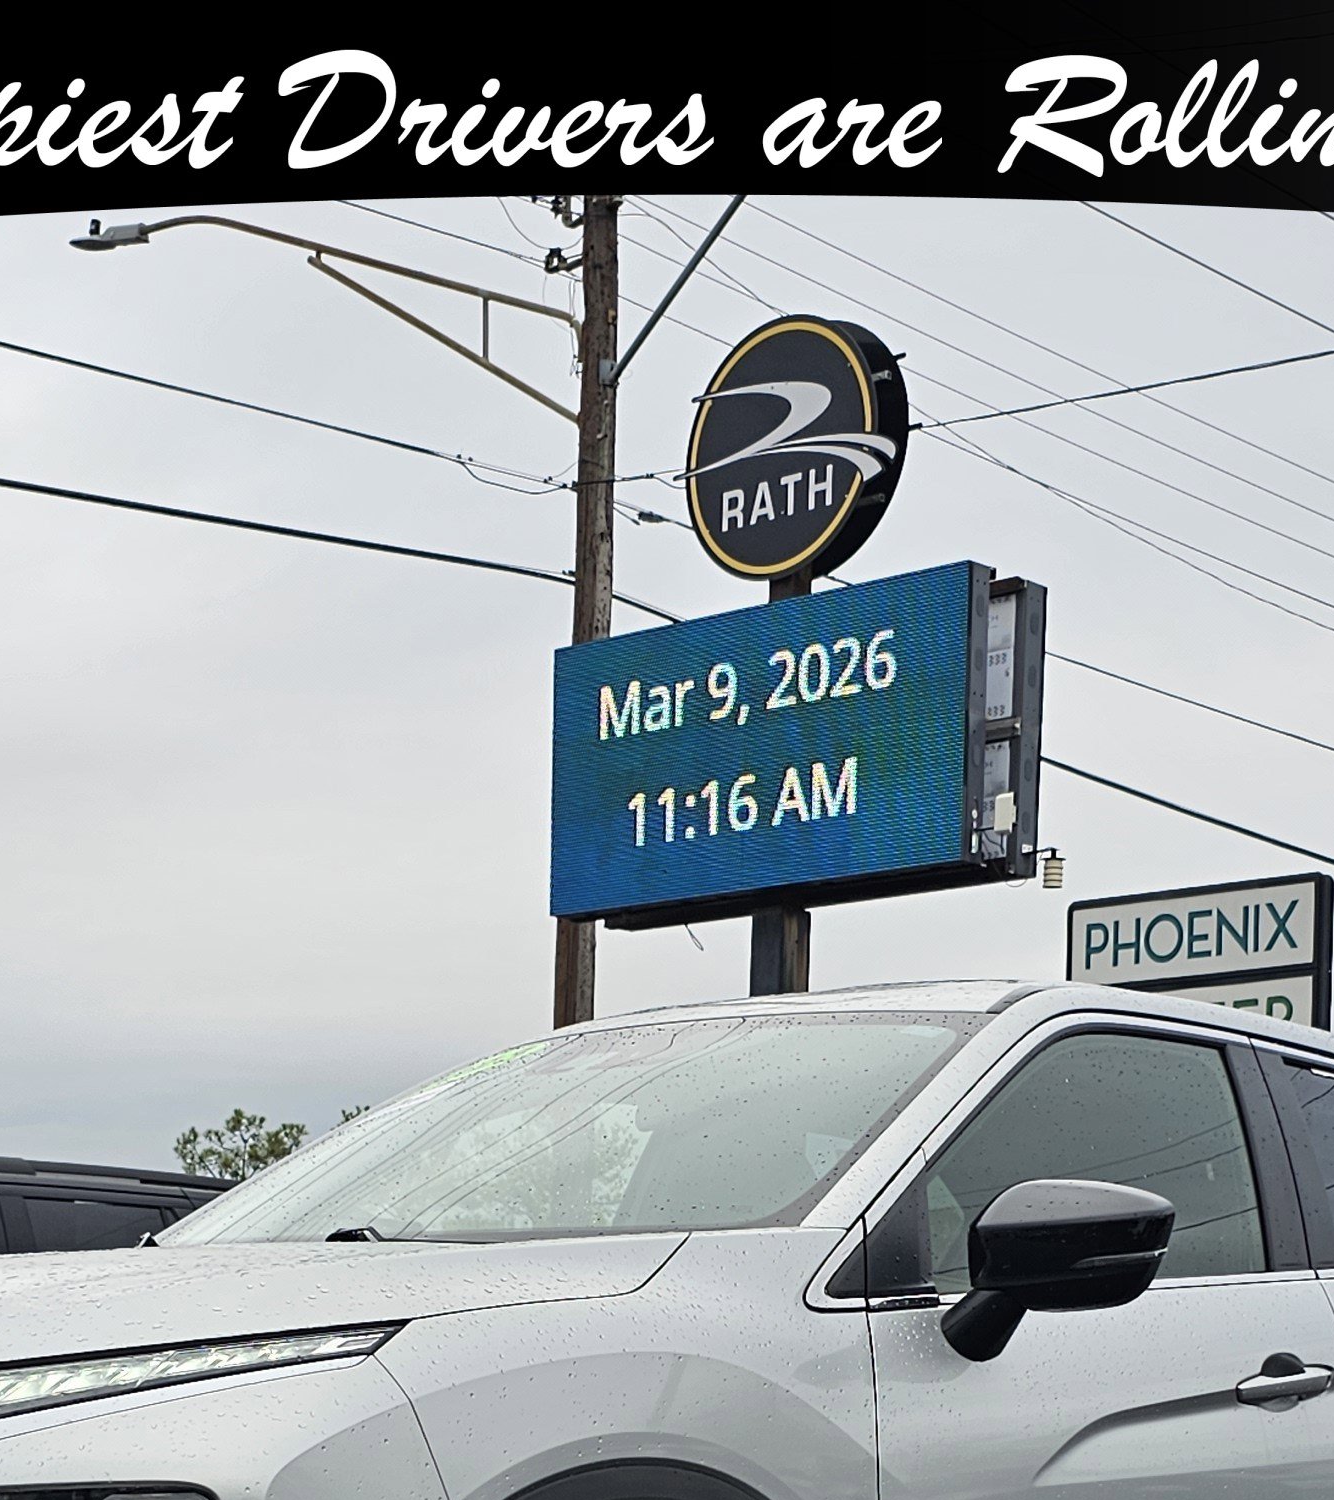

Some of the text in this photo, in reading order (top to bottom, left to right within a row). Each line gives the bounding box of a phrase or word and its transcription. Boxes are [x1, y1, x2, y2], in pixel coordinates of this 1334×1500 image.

[721, 463, 833, 532] RATH
[599, 629, 897, 740] Mar 9, 2026
[628, 756, 857, 846] 11:16 AM
[1085, 899, 1299, 970] PHOENIX
